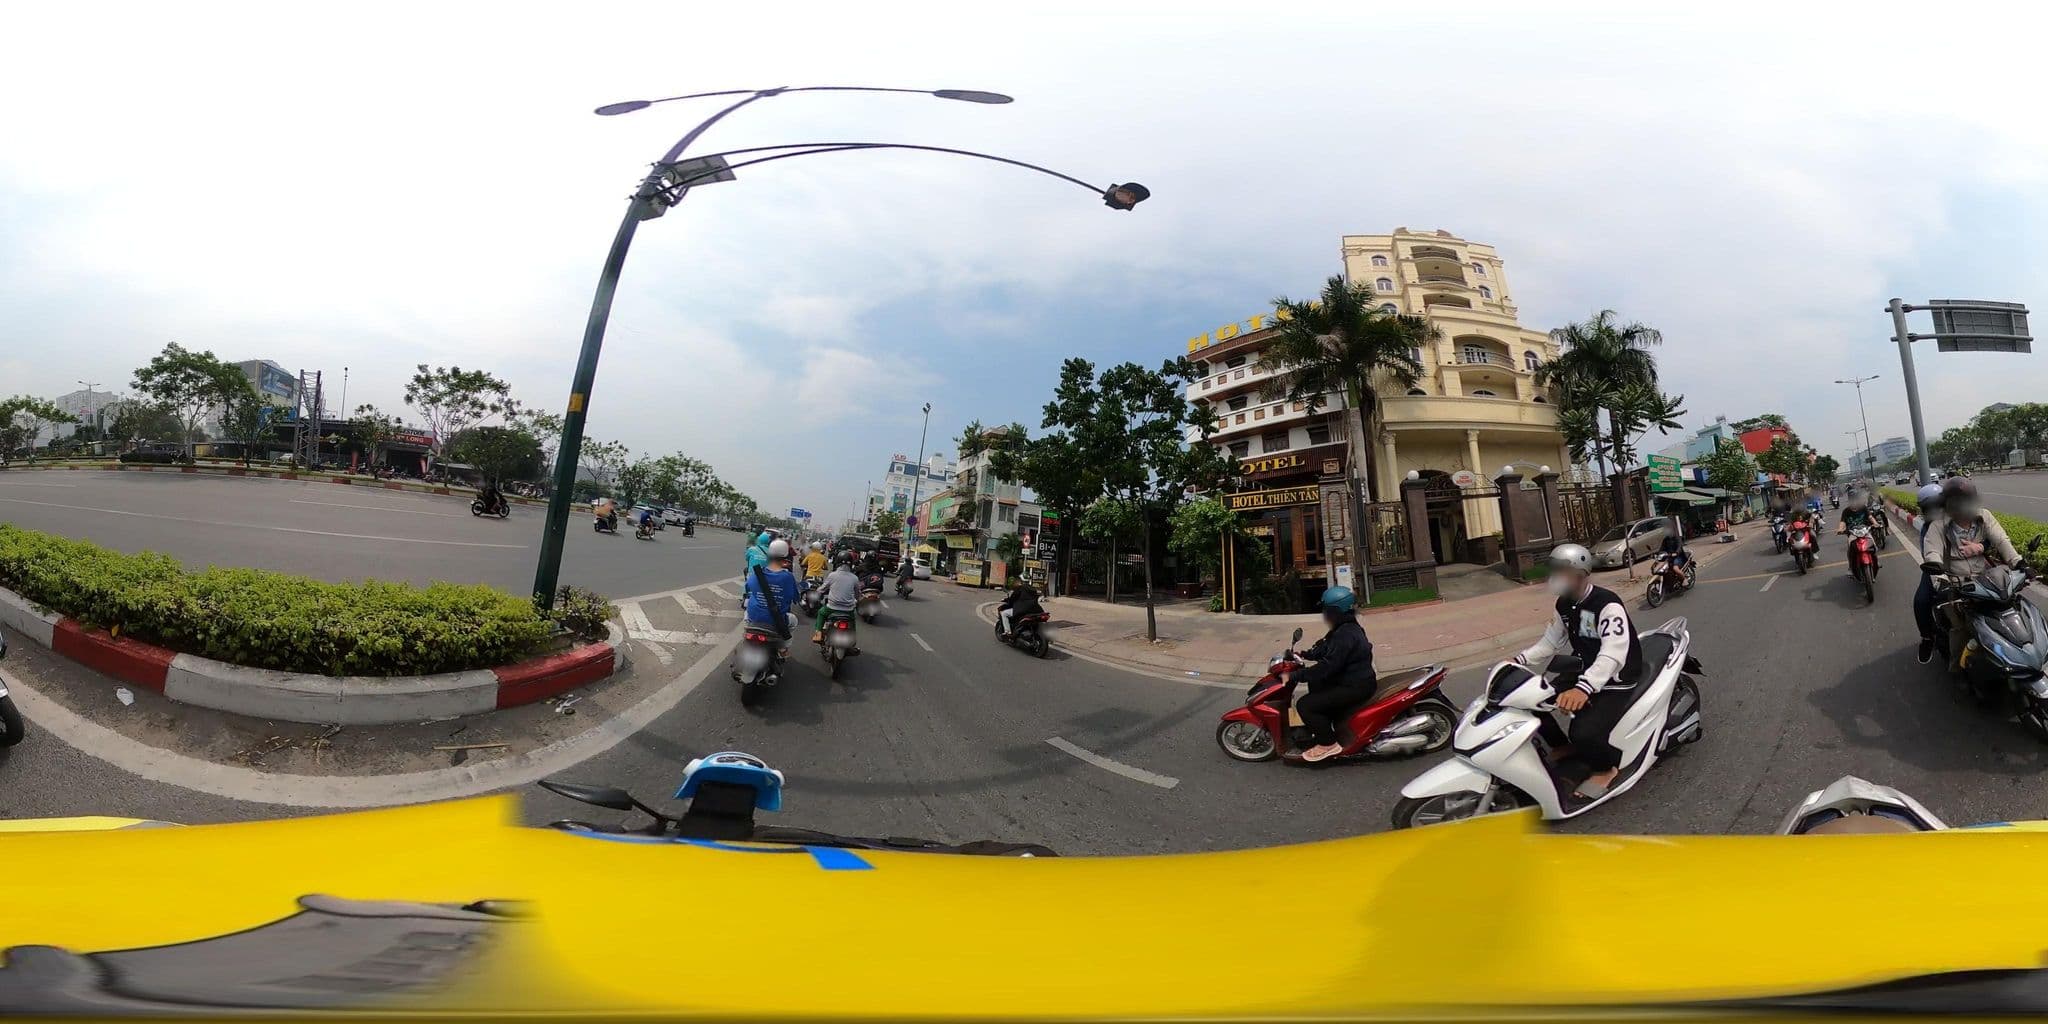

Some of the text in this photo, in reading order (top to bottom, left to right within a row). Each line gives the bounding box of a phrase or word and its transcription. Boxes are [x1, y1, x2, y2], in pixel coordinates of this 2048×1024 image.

[1239, 455, 1306, 475] OTEL
[1232, 494, 1267, 508] HOTEL
[1600, 616, 1624, 637] 23
